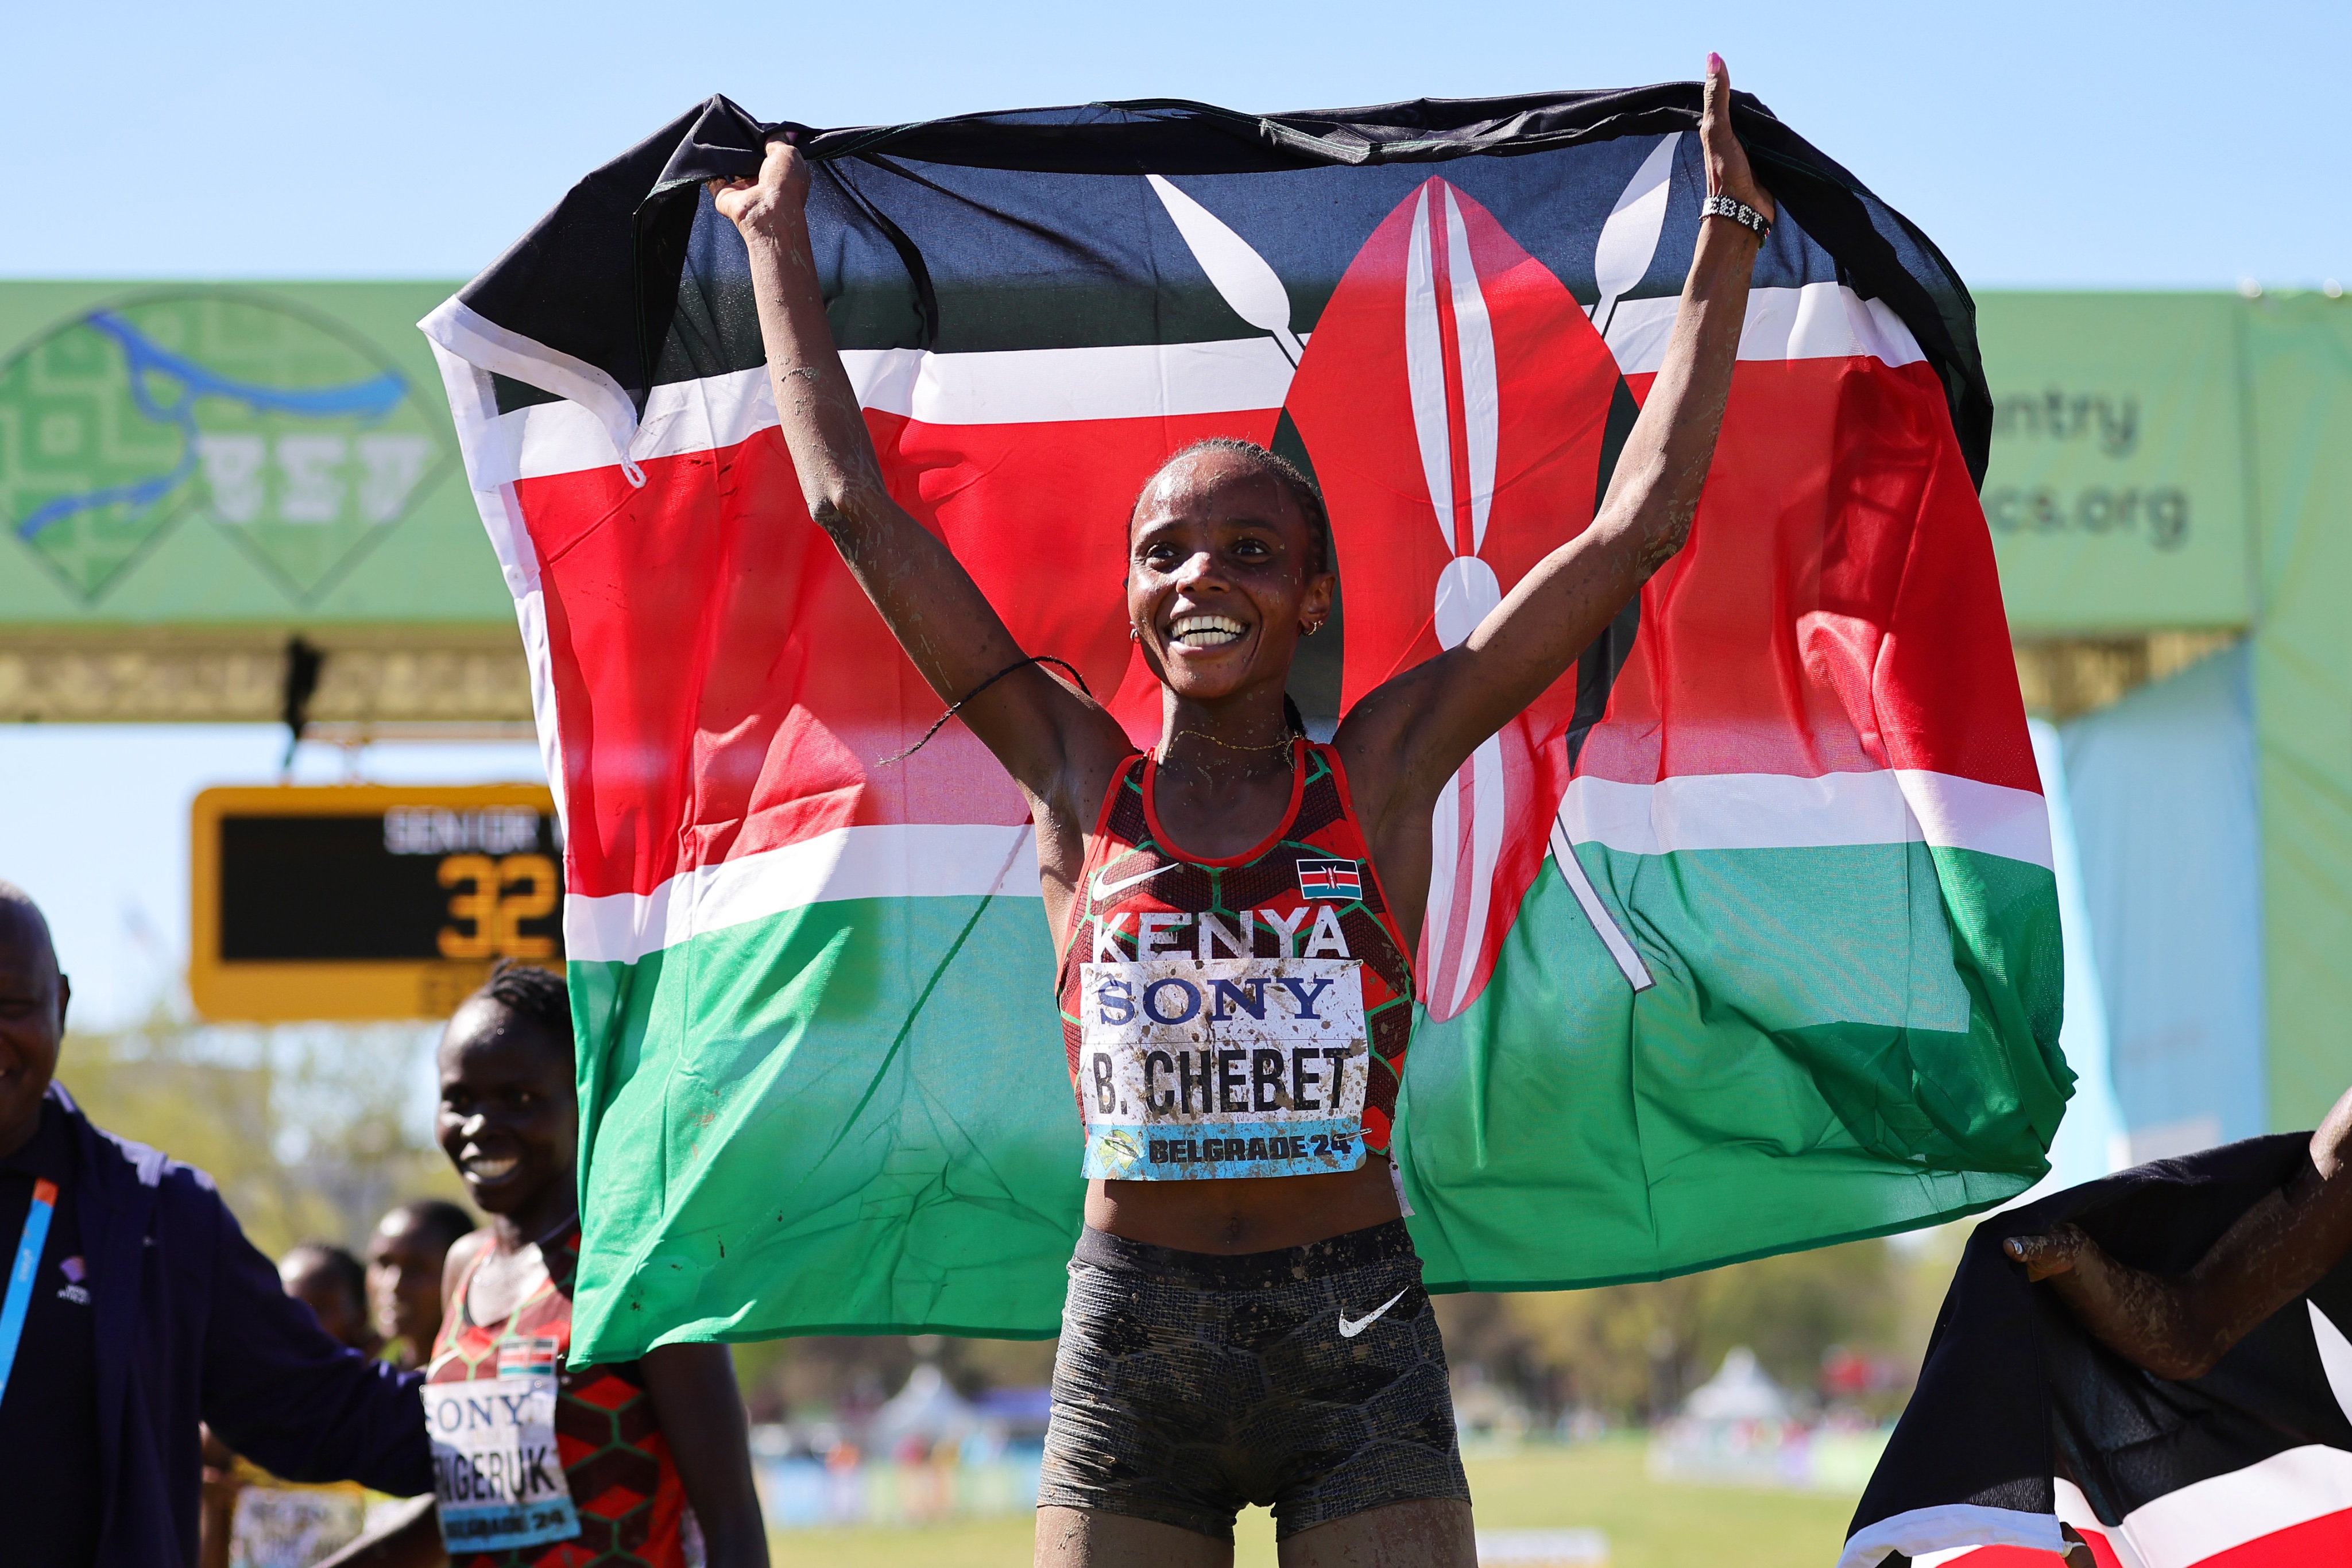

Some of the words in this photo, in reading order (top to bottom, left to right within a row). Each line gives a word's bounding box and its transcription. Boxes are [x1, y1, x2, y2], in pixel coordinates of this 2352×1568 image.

[383, 805, 540, 855] SENIOR
[436, 853, 558, 958] 32
[1093, 905, 1350, 963] KENYA
[1098, 978, 1334, 1025] SONY
[1093, 1052, 1128, 1115] B.
[1144, 1048, 1353, 1116] CHEBET
[1149, 1136, 1309, 1164] BELGRADE
[1312, 1133, 1352, 1157] 24
[425, 1393, 531, 1433] ONY
